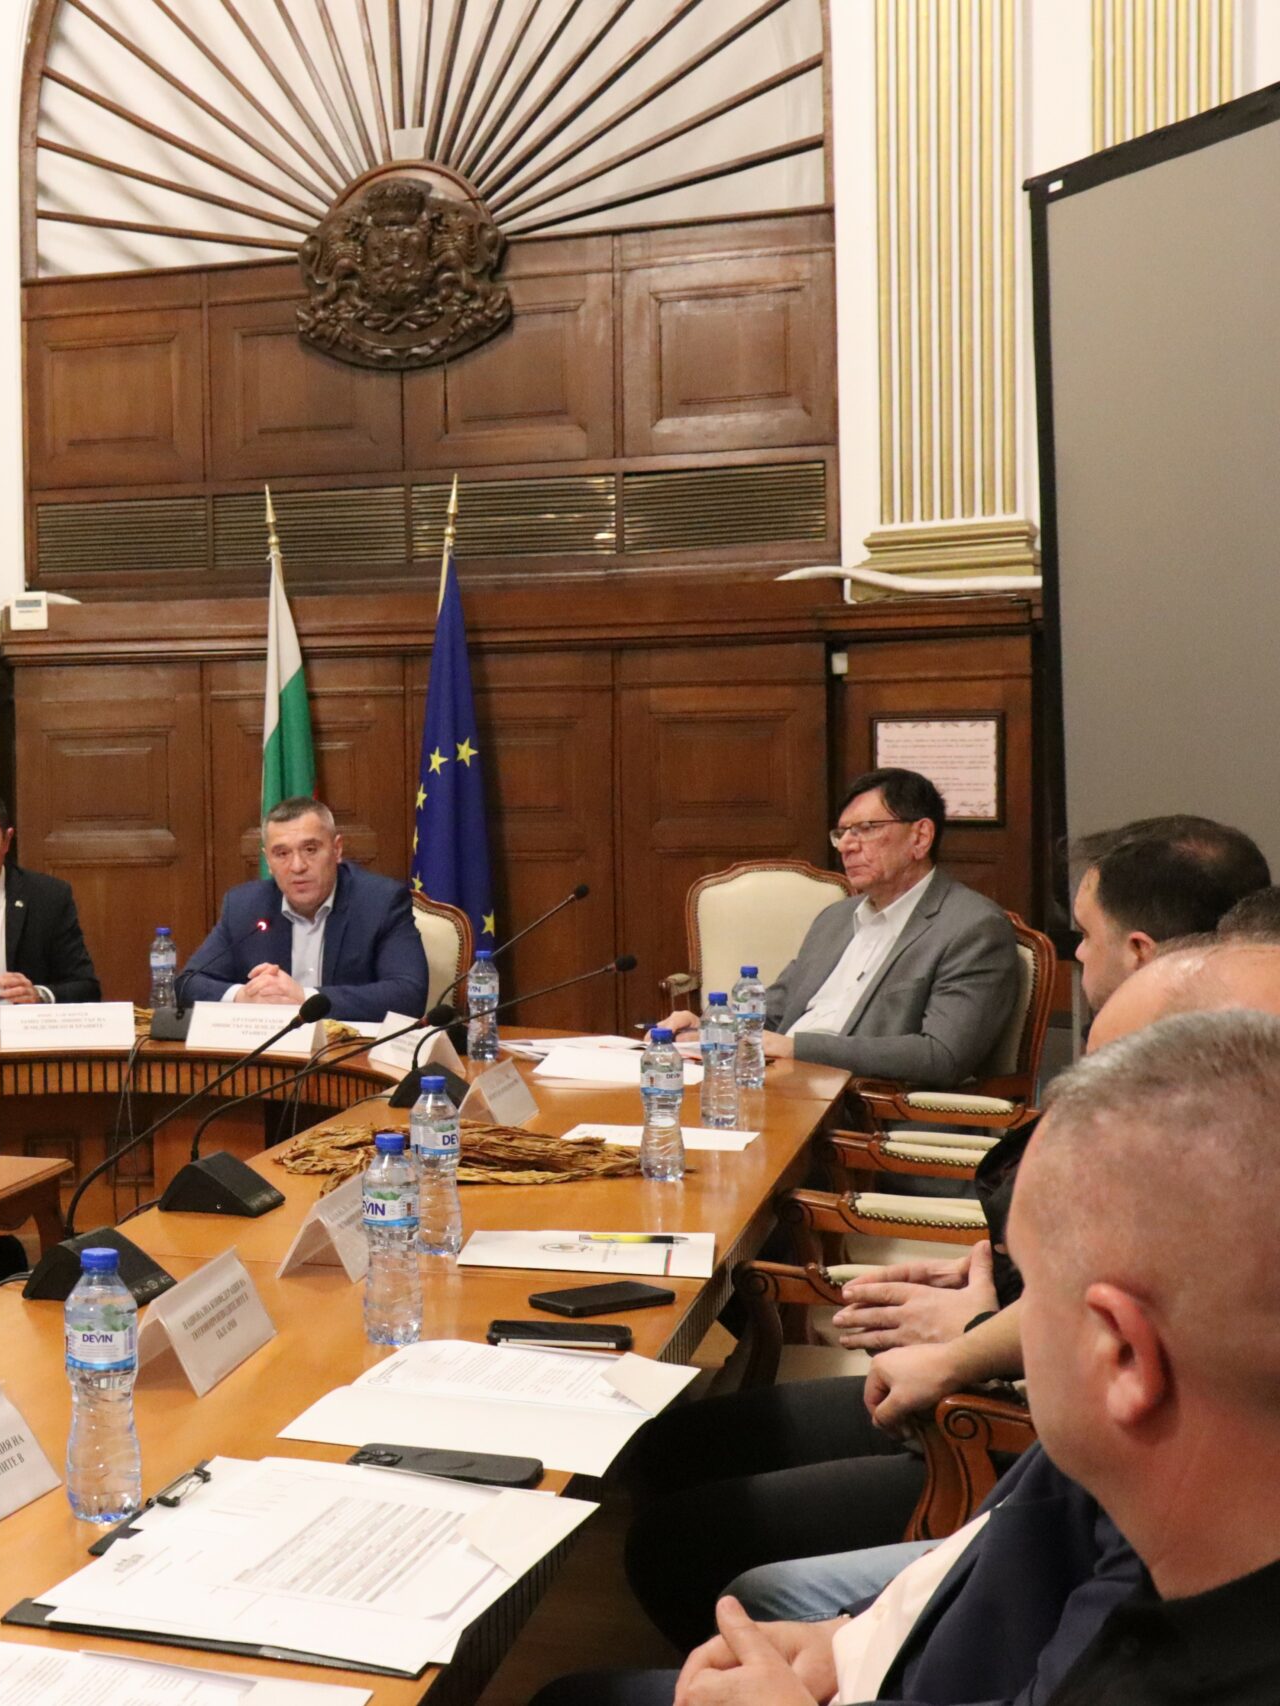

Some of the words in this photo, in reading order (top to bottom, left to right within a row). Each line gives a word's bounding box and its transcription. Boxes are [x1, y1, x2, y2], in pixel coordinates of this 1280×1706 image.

[362, 1200, 385, 1216] EVIN
[82, 1333, 113, 1344] DEVIN
[12, 1434, 25, 1449] НА
[16, 1452, 25, 1464] В
